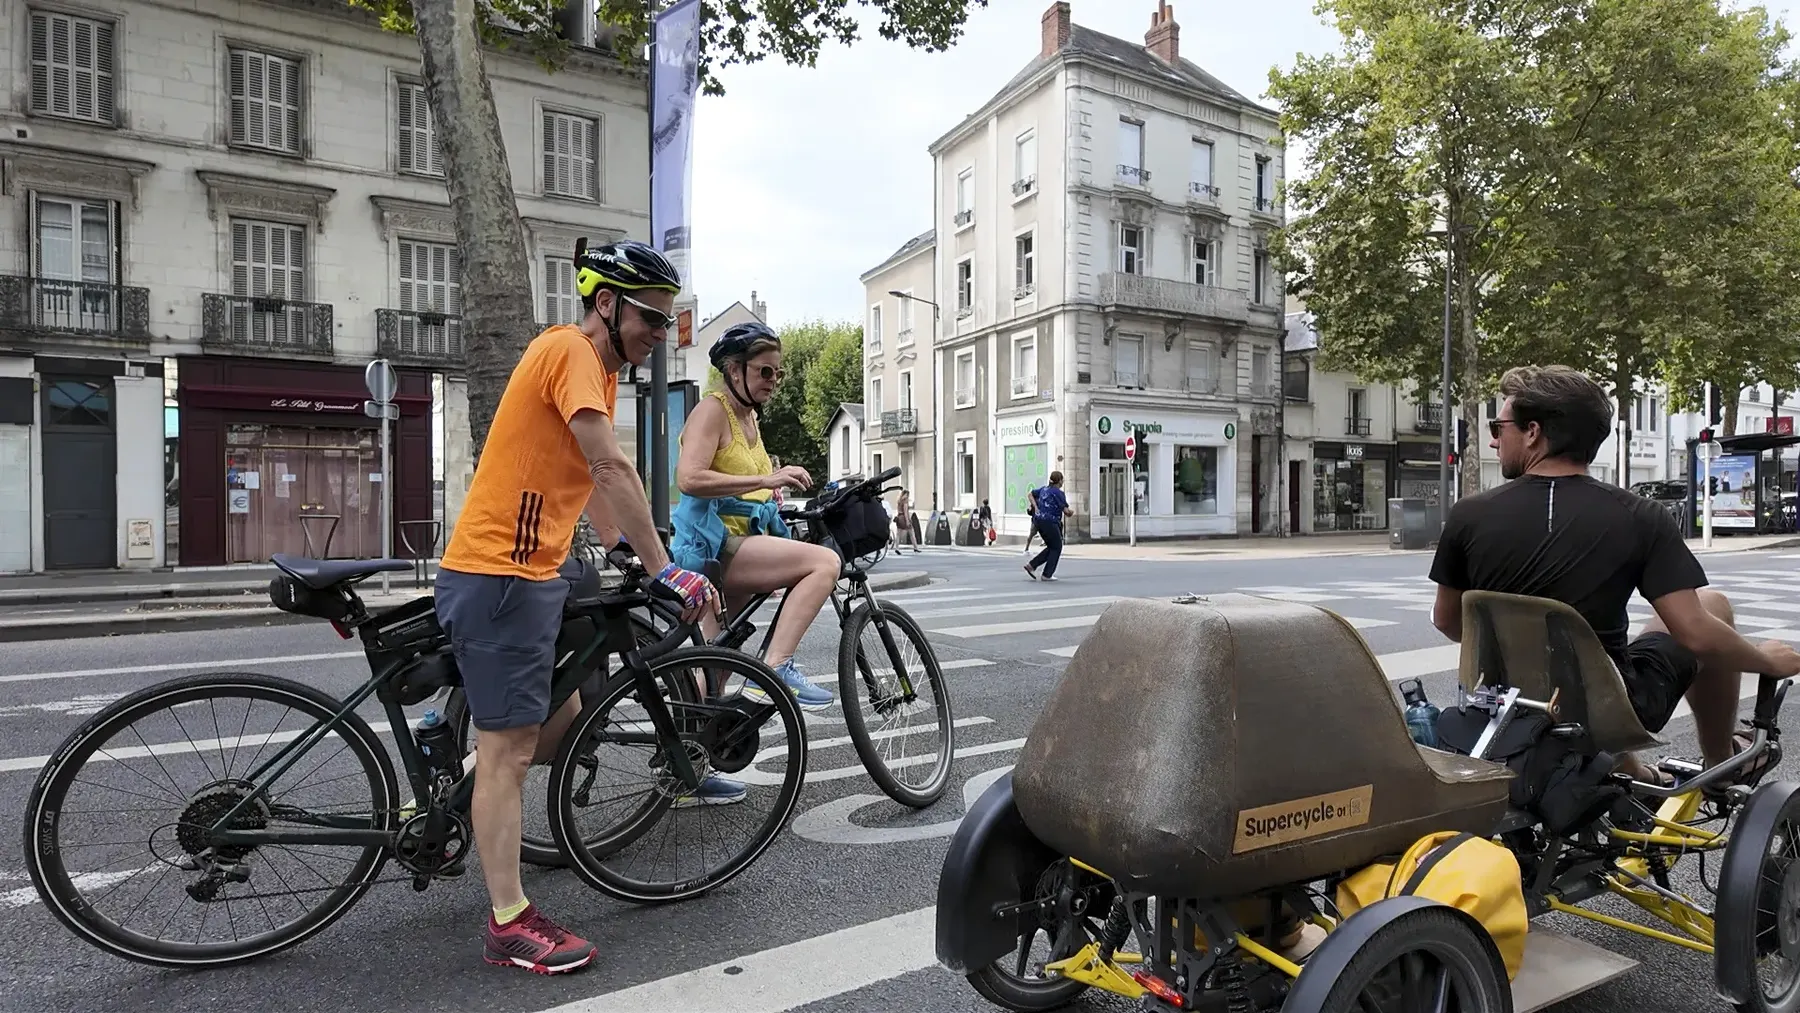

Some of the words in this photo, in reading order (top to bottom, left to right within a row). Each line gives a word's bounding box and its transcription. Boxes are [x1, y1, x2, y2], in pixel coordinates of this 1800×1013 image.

[270, 399, 287, 407] Le
[1001, 423, 1034, 439] pressing
[44, 810, 55, 827] DT
[1245, 801, 1334, 837] Supercycle
[1337, 806, 1346, 818] 01
[43, 828, 54, 856] SWISS
[674, 884, 686, 892] DT
[688, 876, 709, 887] SWISS
